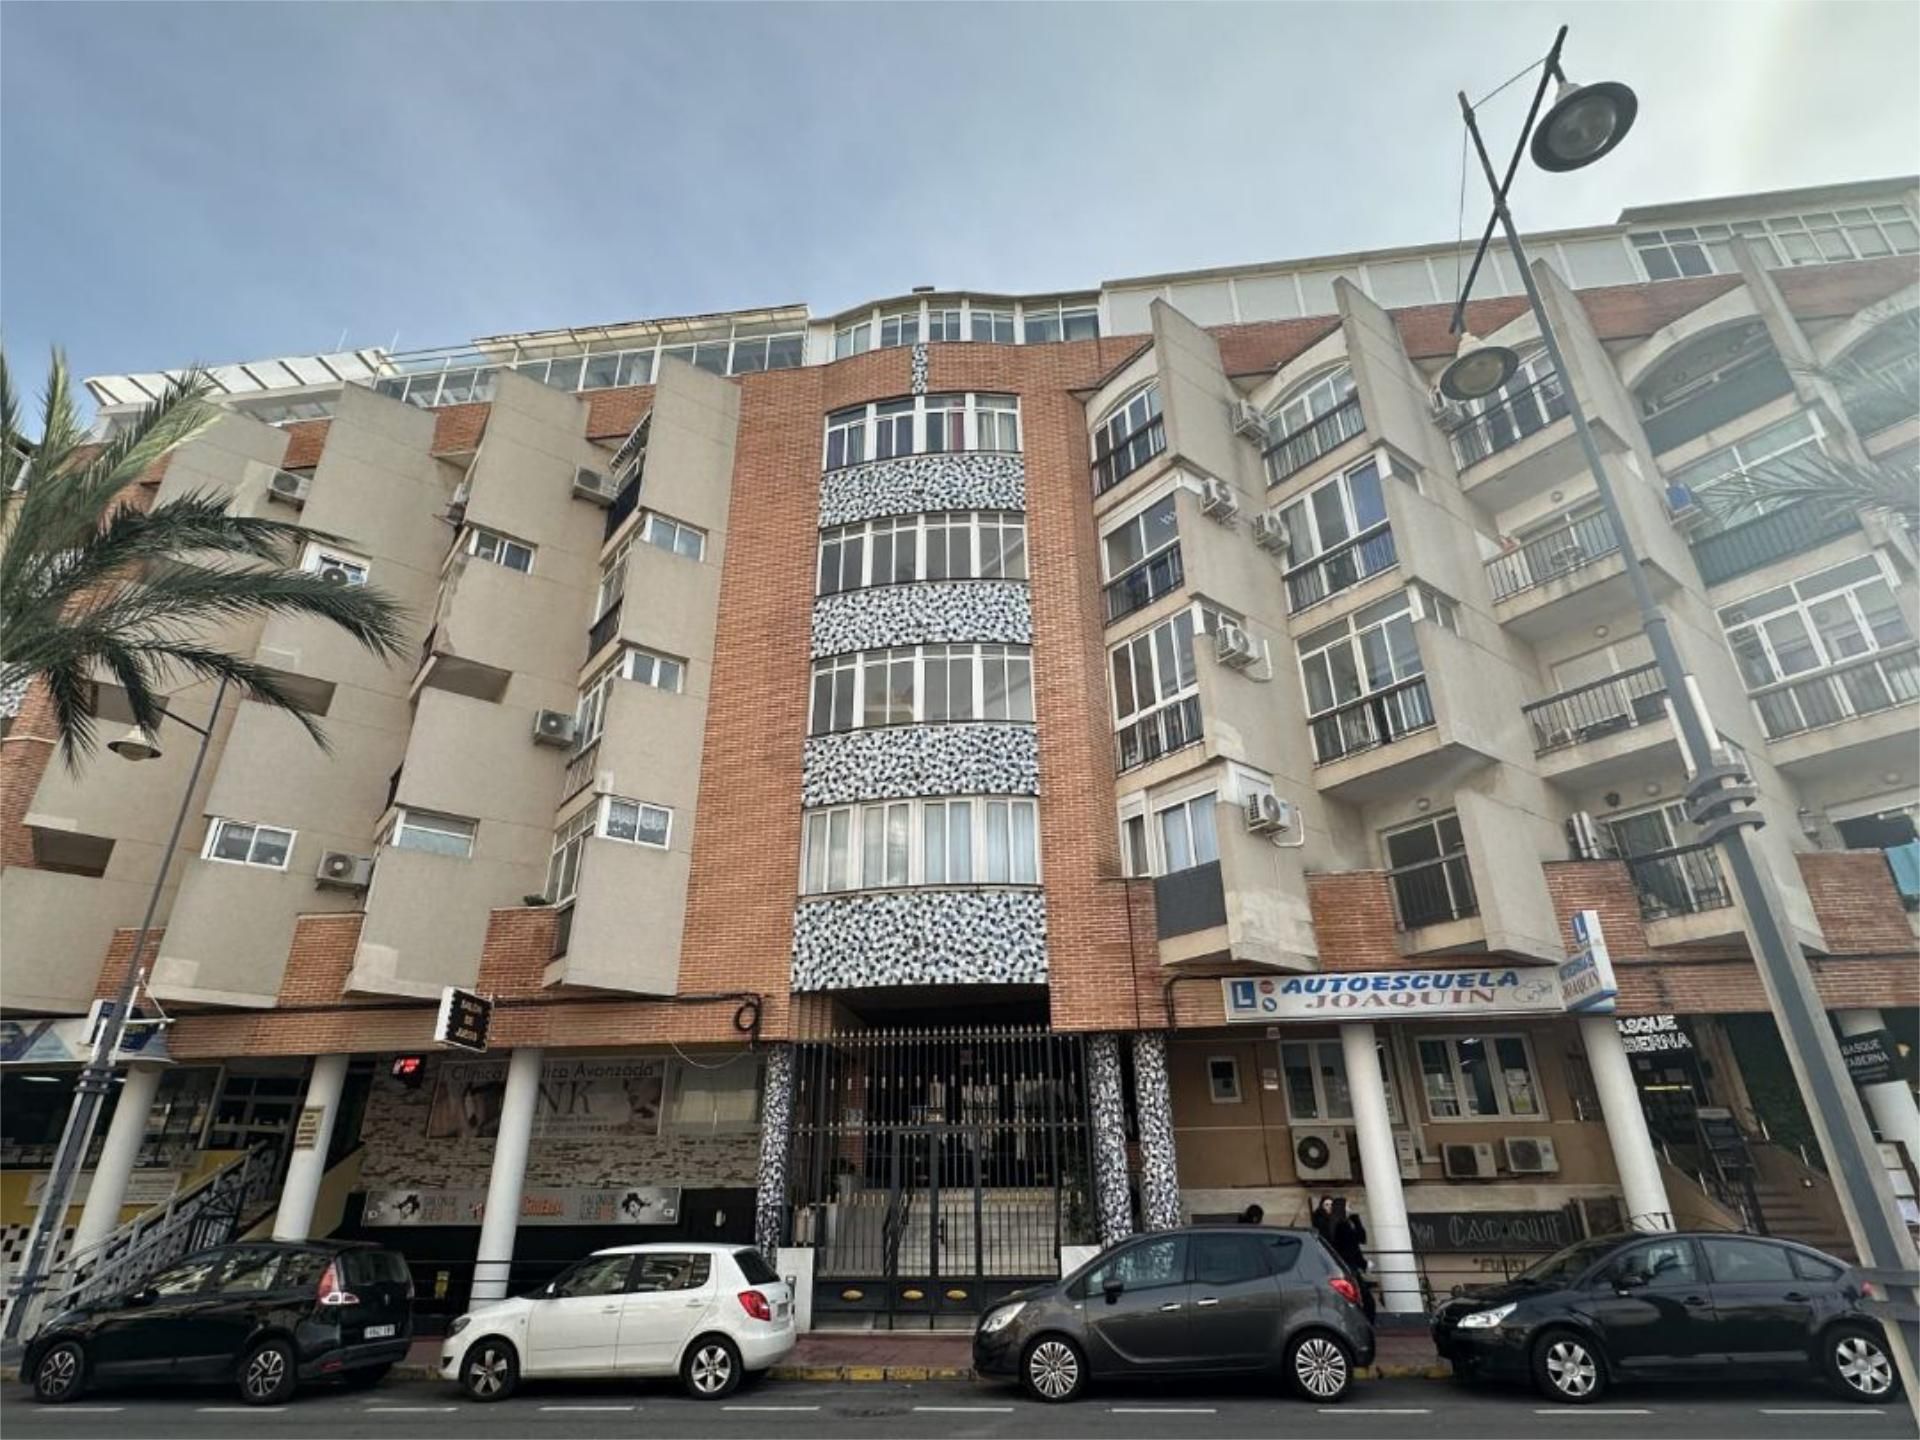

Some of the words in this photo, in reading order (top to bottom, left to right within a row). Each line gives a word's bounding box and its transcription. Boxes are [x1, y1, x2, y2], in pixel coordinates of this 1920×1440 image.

[1281, 971, 1519, 994] AUTOESCUELA
[1236, 983, 1252, 1005] L
[1304, 989, 1496, 1008] JOAQUIN
[1616, 1014, 1678, 1034] ASQUE
[1622, 1032, 1693, 1053] BERNA
